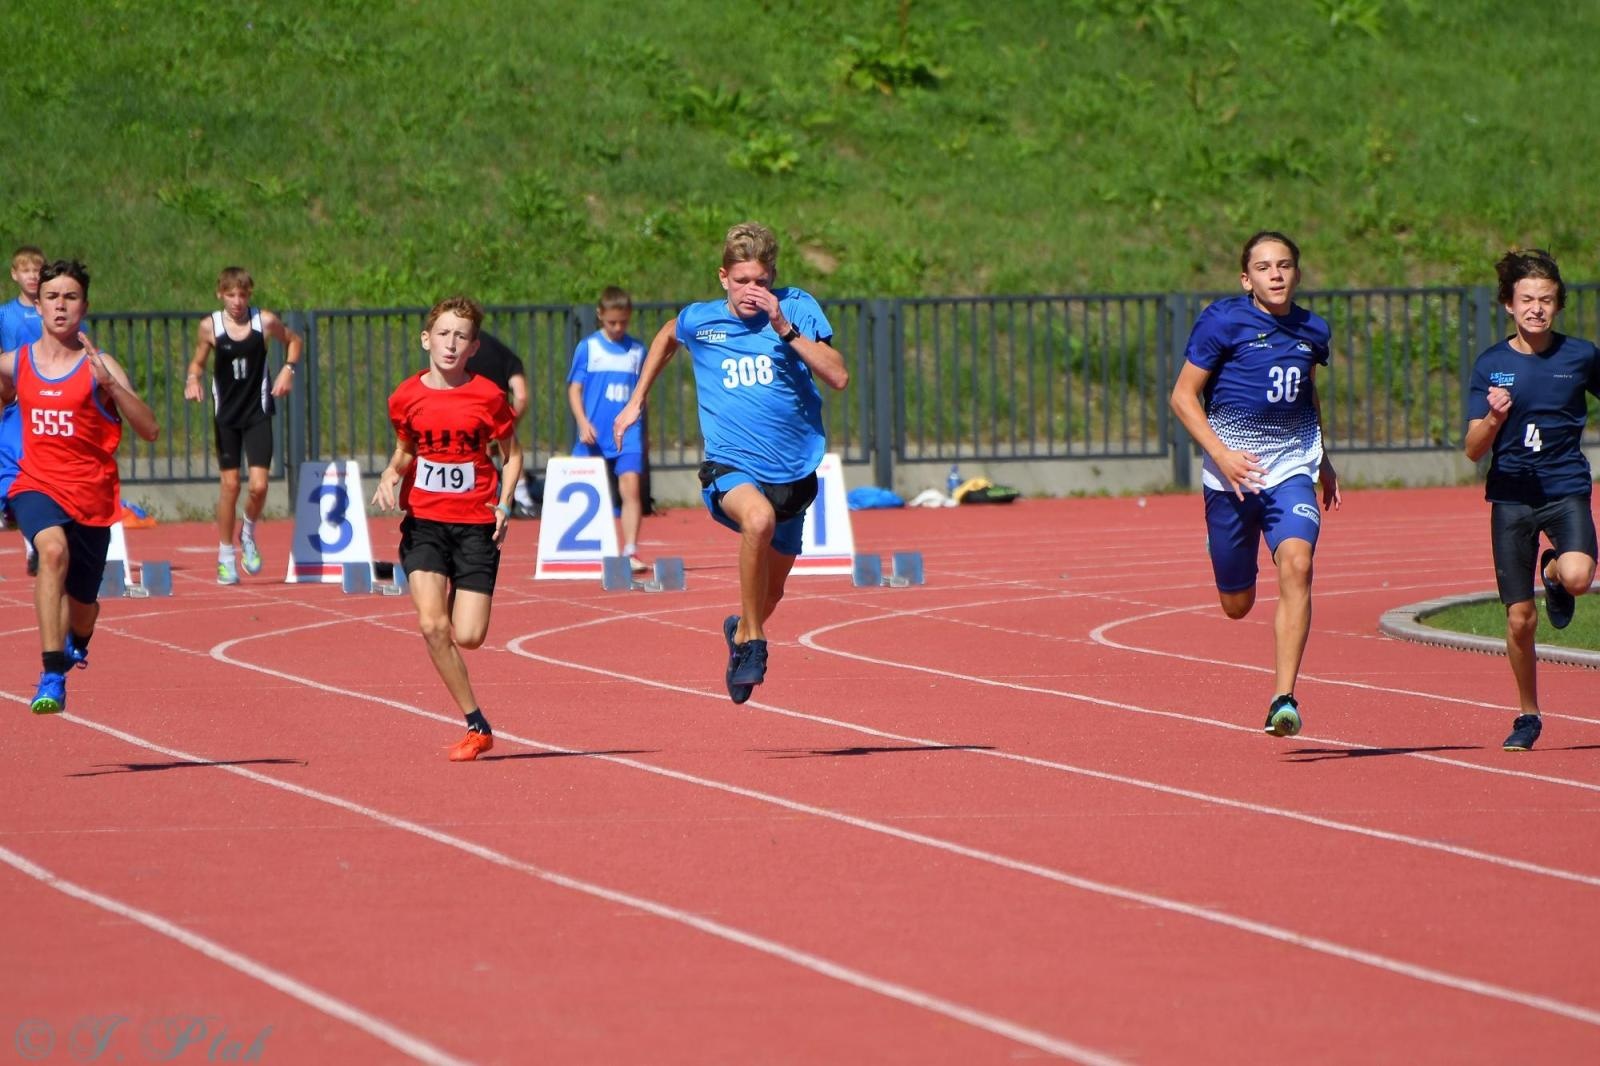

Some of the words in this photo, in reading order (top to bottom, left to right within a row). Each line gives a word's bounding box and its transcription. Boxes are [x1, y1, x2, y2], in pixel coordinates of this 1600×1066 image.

[709, 333, 727, 342] TEAM
[231, 358, 247, 380] 11
[721, 355, 774, 389] 308
[1266, 366, 1301, 403] 30
[31, 408, 75, 437] 555
[1524, 423, 1543, 452] 4
[423, 463, 464, 489] 719
[307, 484, 353, 554] 3
[556, 482, 602, 552] 2
